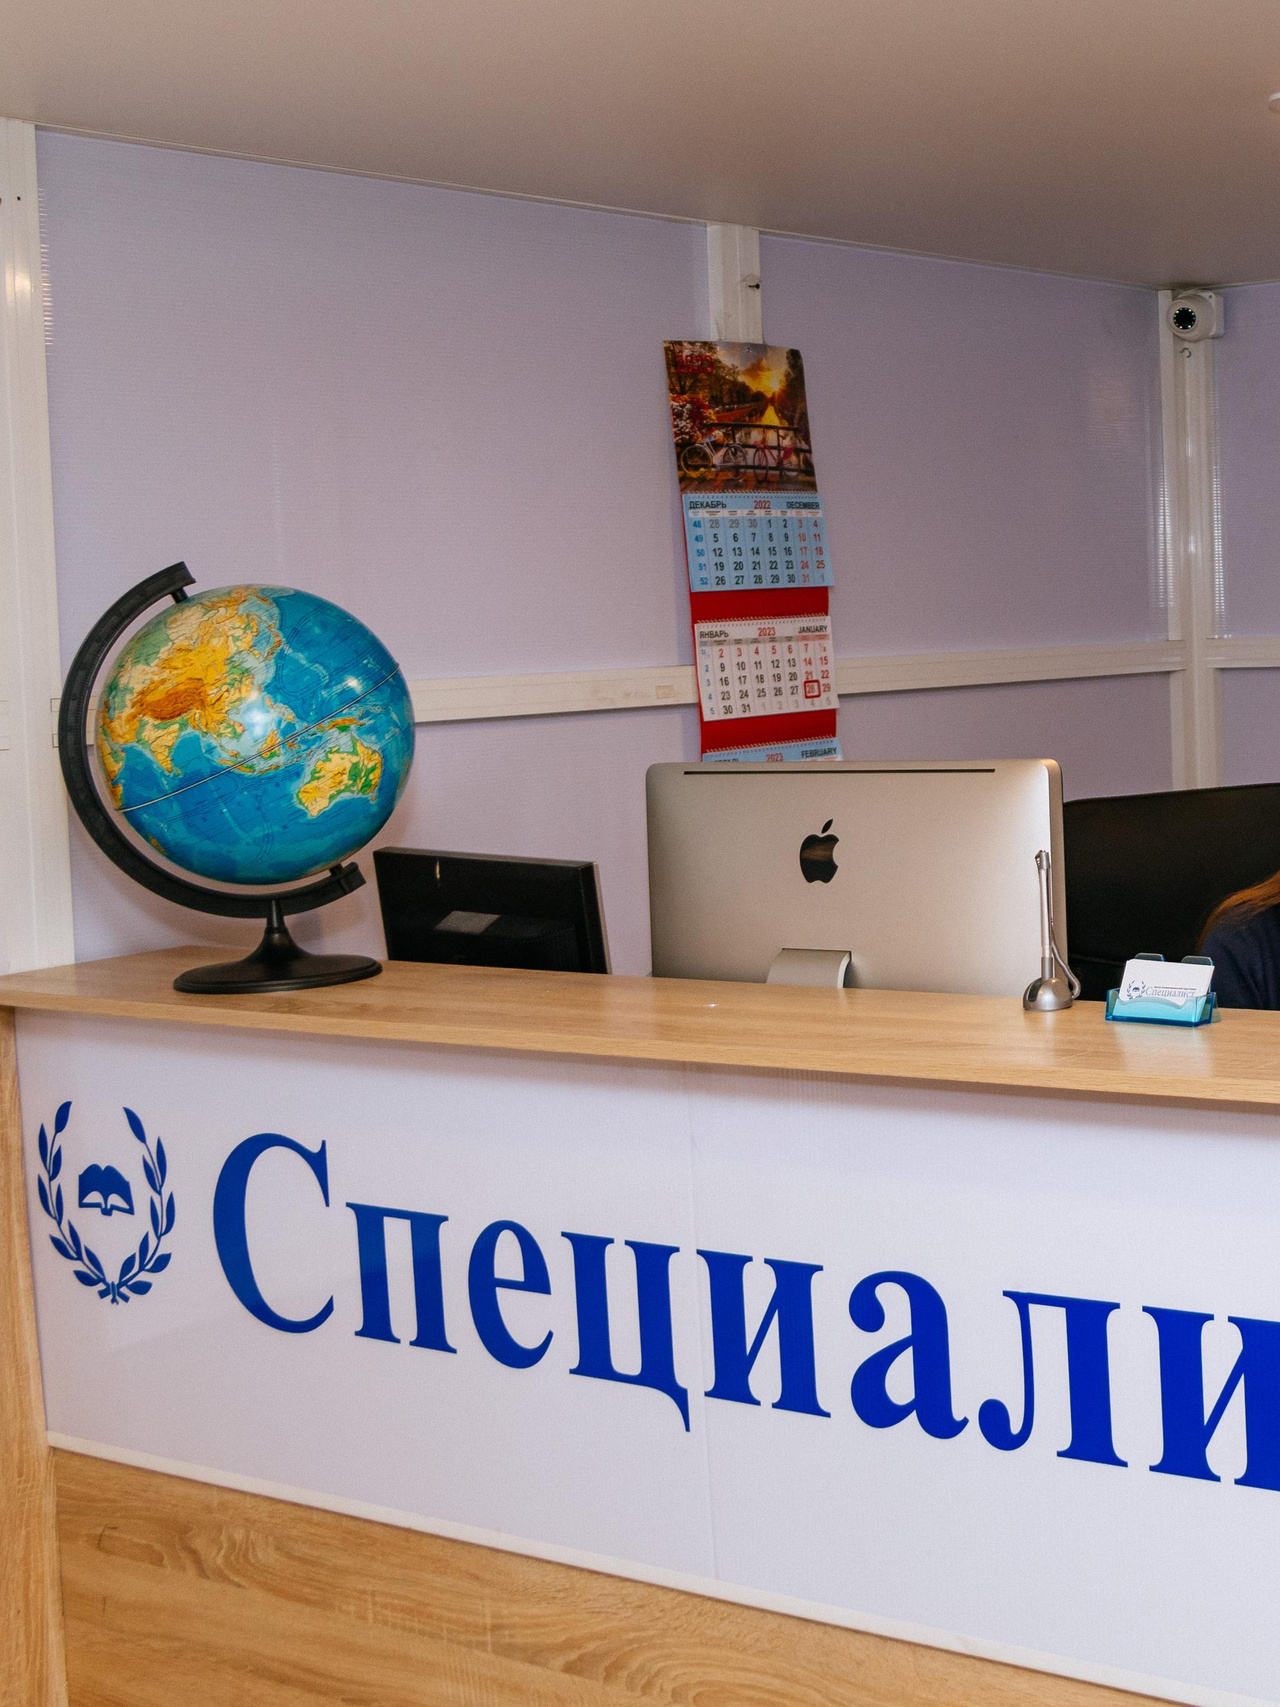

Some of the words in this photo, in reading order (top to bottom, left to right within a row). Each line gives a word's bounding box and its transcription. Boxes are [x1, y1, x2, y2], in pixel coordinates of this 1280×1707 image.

[675, 354, 714, 374] 2023
[689, 501, 727, 509] ДЕКАБРЬ
[754, 501, 771, 509] 2022
[710, 520, 720, 528] 28
[729, 519, 739, 528] 29
[768, 520, 772, 528] 1
[782, 519, 788, 528] 2
[713, 534, 719, 542] 5
[733, 534, 738, 542] 6
[752, 533, 756, 542] 7
[769, 534, 773, 542] 8
[784, 533, 789, 541] 9
[798, 534, 807, 542] 10
[713, 548, 723, 557] 12
[732, 547, 742, 556] 13
[751, 547, 760, 555] 14
[768, 547, 777, 555] 15
[784, 547, 792, 555] 16
[800, 547, 807, 555] 17
[815, 547, 823, 555] 18
[714, 562, 724, 571] 19
[733, 562, 743, 570] 20
[752, 561, 761, 570] 21
[769, 561, 778, 569] 22
[786, 561, 794, 569] 23
[801, 561, 809, 569] 24
[816, 560, 825, 569] 25
[715, 576, 726, 585] 26
[735, 576, 744, 584] 27
[754, 575, 763, 584] 28
[771, 575, 780, 583] 29
[787, 574, 795, 583] 30
[802, 575, 809, 583] 31
[700, 630, 729, 638] ЯНВАРЬ
[758, 628, 776, 636] 2023
[799, 625, 827, 633] JANUARY
[719, 649, 724, 657] 2
[737, 648, 742, 656] 3
[754, 647, 759, 655] 4
[772, 646, 776, 654] 5
[788, 645, 793, 653] 6
[804, 644, 808, 652] 7
[720, 663, 725, 672] 9
[737, 662, 746, 670] 10
[754, 661, 762, 669] 11
[771, 660, 780, 668] 12
[787, 659, 796, 667] 13
[804, 658, 812, 666] 14
[820, 657, 828, 665] 15
[720, 677, 729, 686] 16
[738, 676, 747, 685] 17
[756, 675, 764, 683] 18
[772, 673, 781, 682] 19
[789, 672, 797, 681] 20
[806, 671, 813, 679] 21
[821, 670, 829, 678] 22
[721, 691, 731, 700] 23
[740, 690, 749, 699] 24
[757, 689, 766, 697] 25
[774, 687, 783, 696] 26
[790, 686, 798, 695] 27
[807, 685, 815, 693] 28
[823, 684, 831, 692] 29
[724, 705, 733, 714] 30
[742, 704, 750, 712] 31
[779, 701, 782, 710] 2
[811, 698, 815, 706] 4
[801, 747, 836, 758] FEBRUARY
[1145, 987, 1196, 998] Специалист
